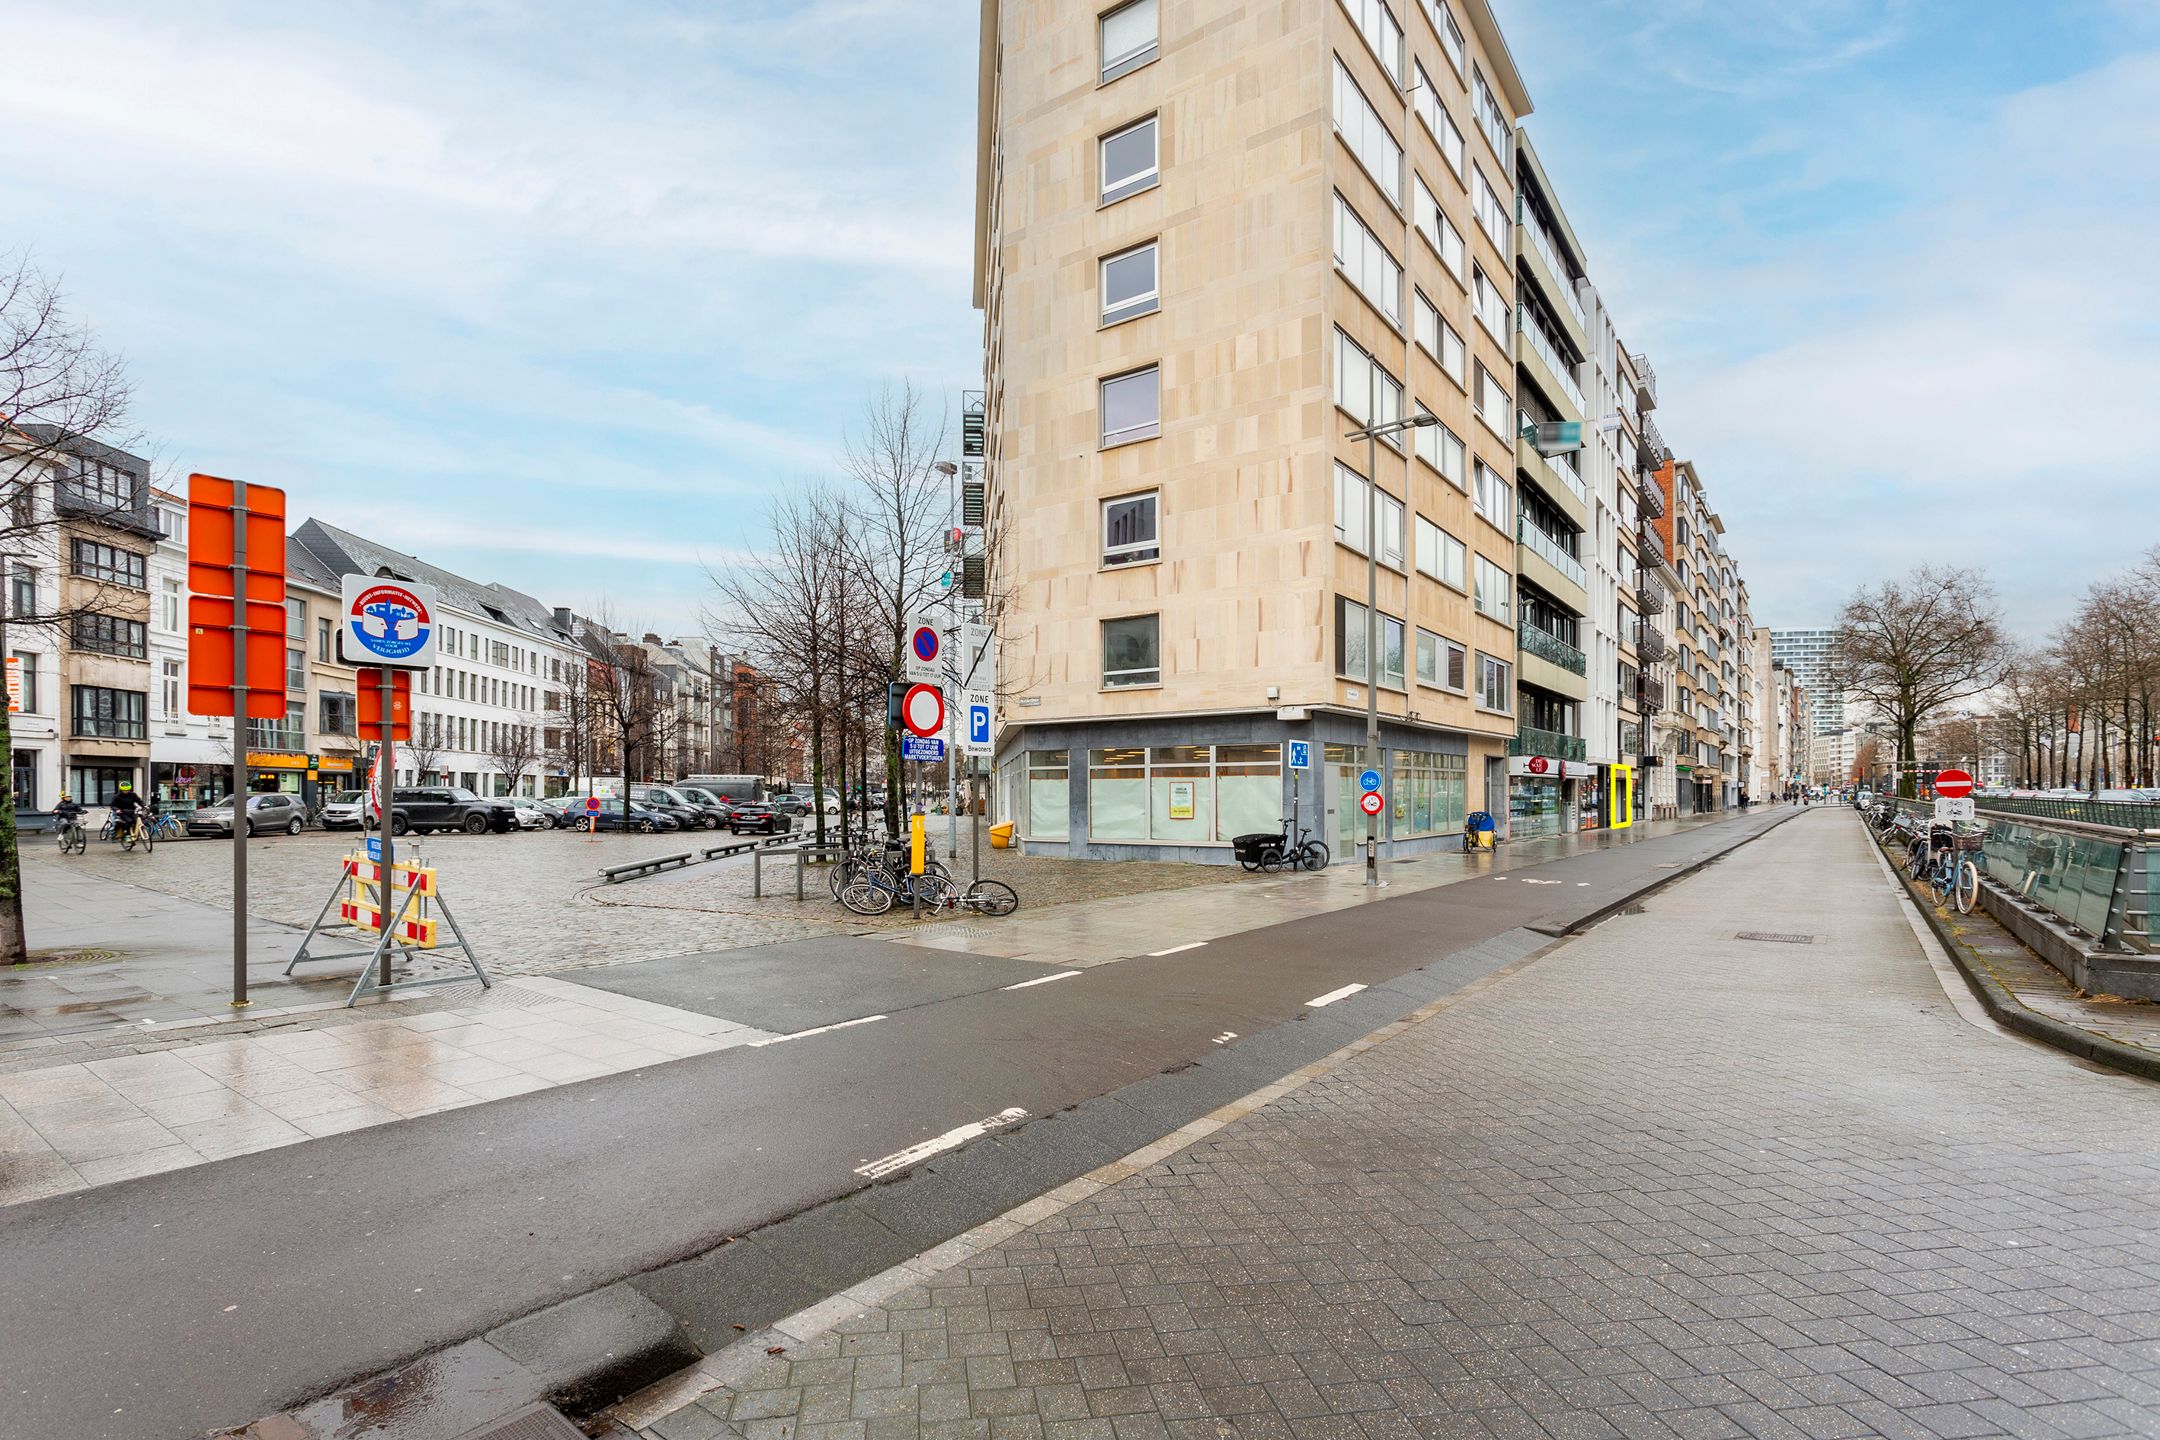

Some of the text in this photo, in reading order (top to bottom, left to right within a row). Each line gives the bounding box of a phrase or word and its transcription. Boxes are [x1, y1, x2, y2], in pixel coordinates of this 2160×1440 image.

[918, 616, 934, 626] ZONE
[970, 627, 987, 637] ZONE
[373, 643, 410, 654] VEILIGHEID
[970, 695, 989, 704] ZONE
[973, 712, 986, 736] P
[968, 745, 992, 753] Bewoners
